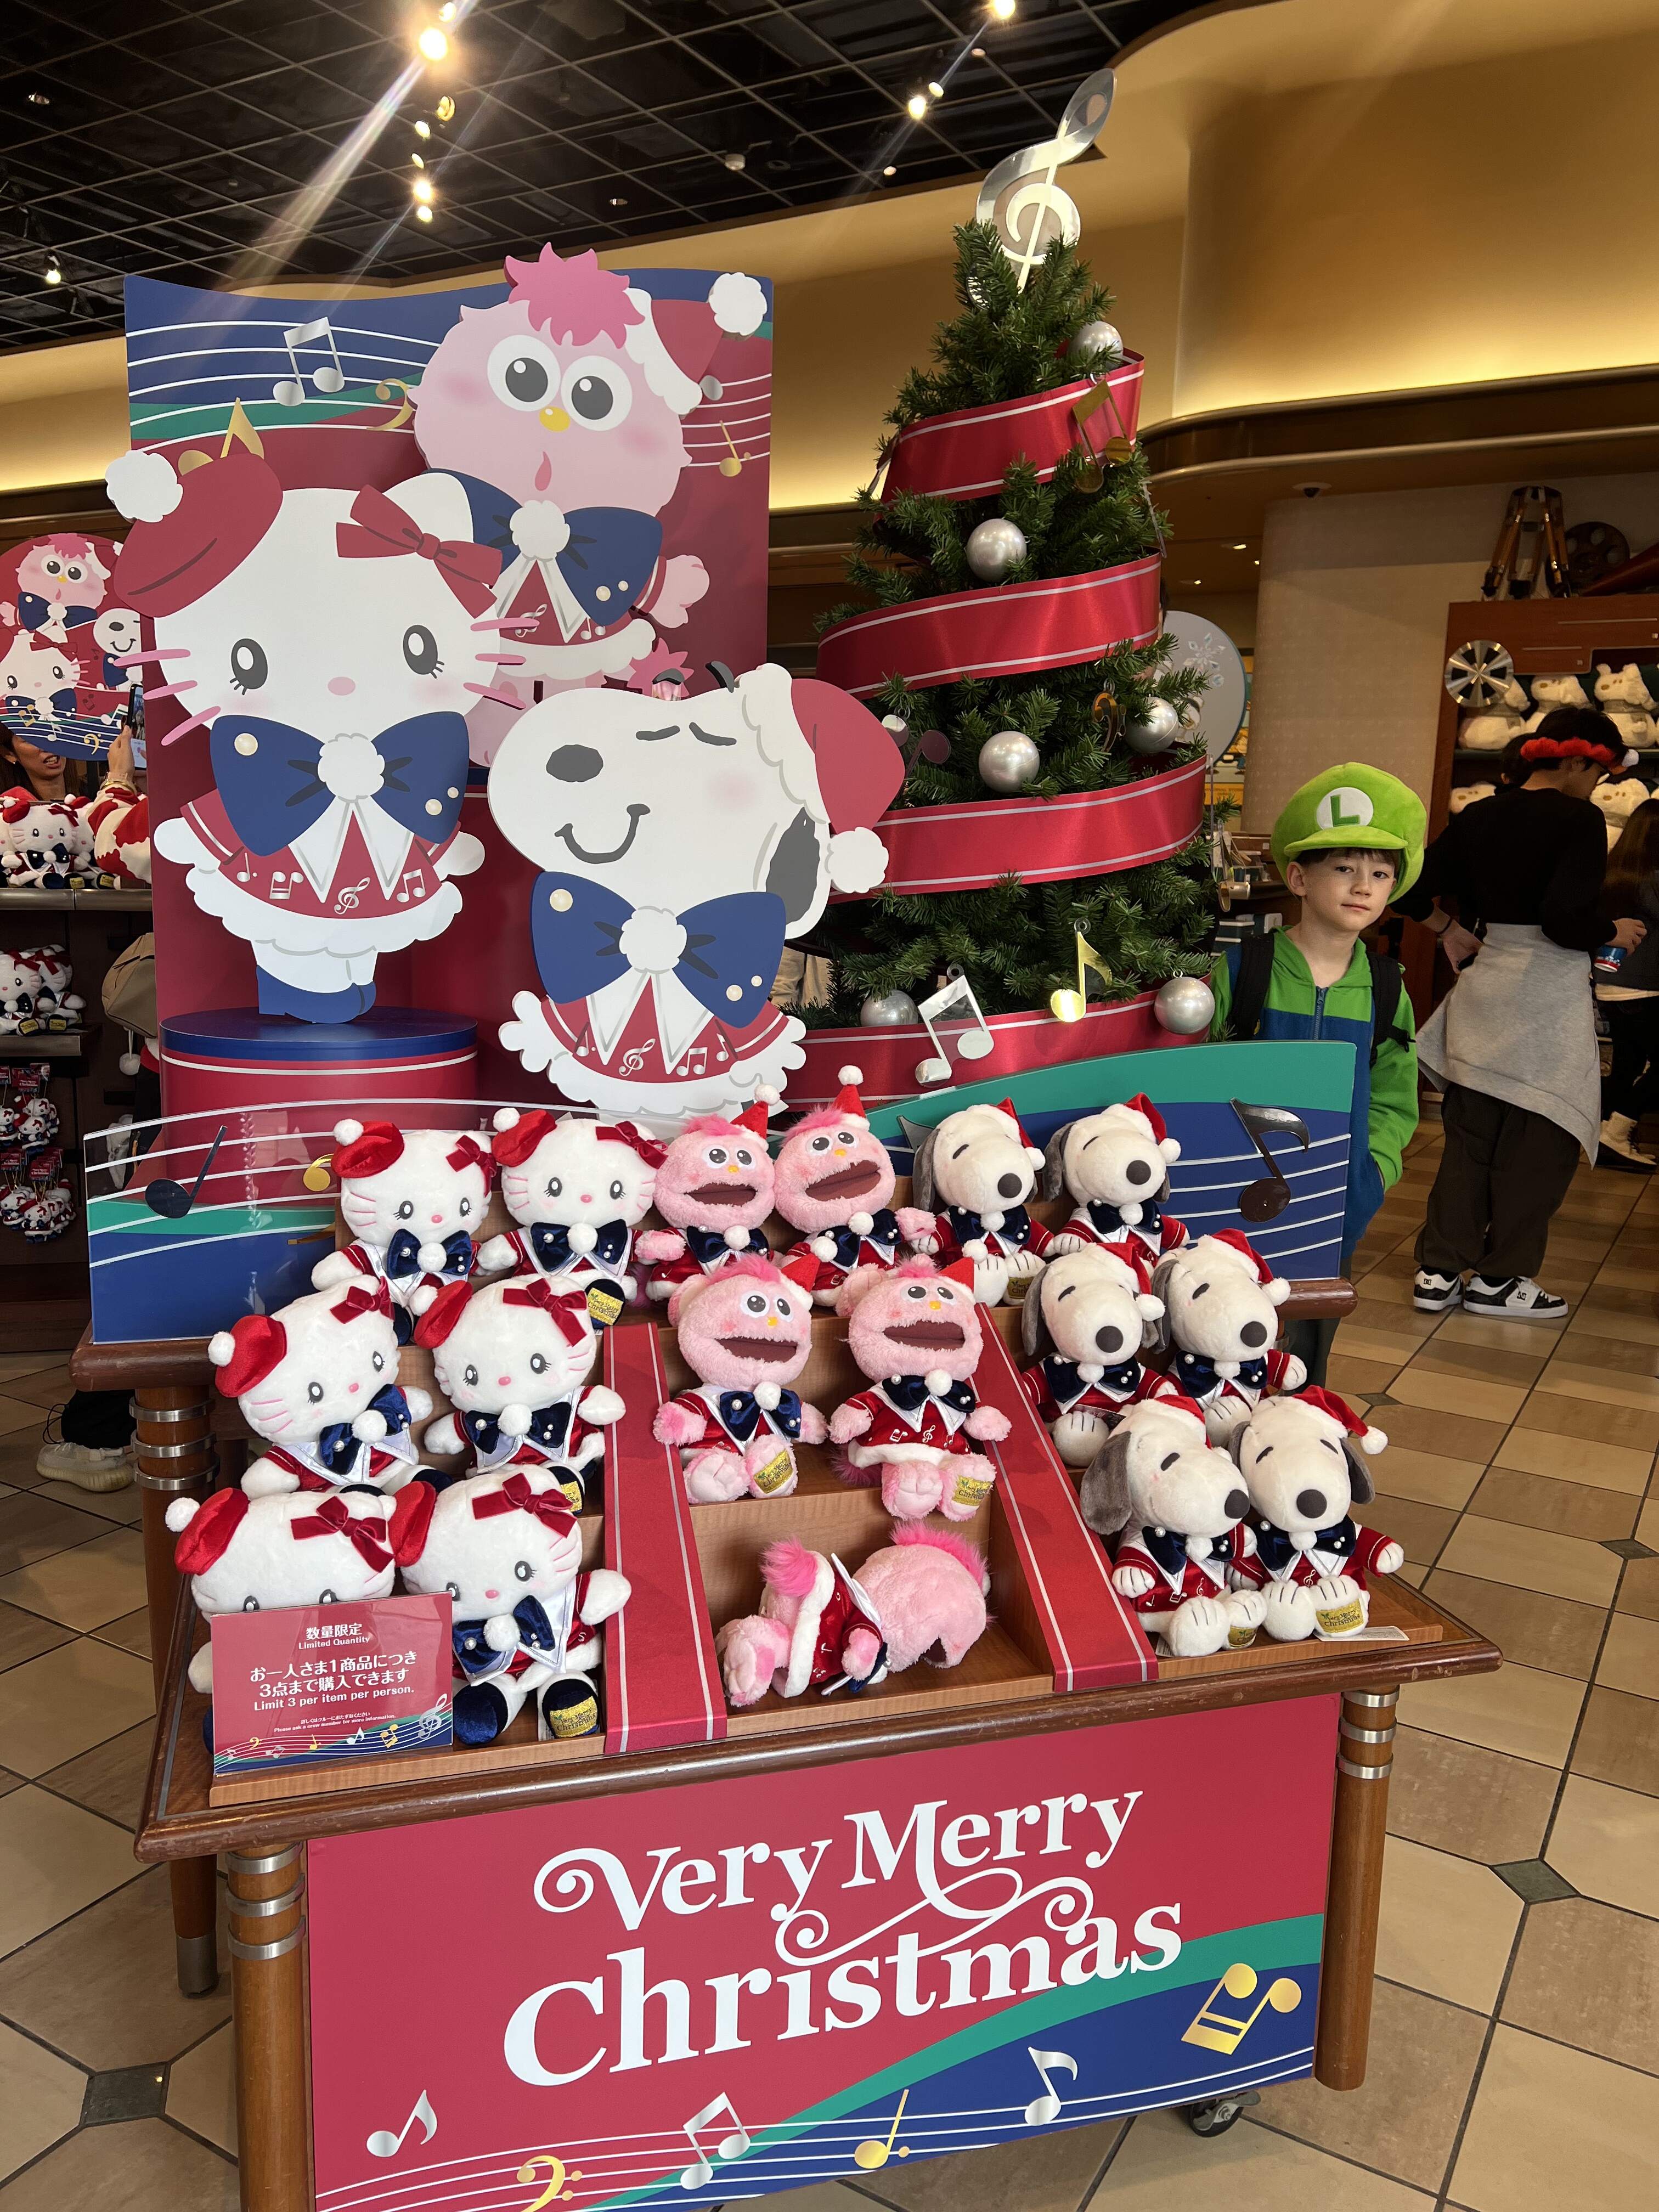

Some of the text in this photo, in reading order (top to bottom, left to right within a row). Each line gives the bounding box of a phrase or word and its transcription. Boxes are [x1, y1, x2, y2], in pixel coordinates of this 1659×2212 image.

[1330, 794, 1359, 827] L
[298, 1636, 370, 1650] Limited Quantity
[306, 1622, 362, 1640] 数量限定
[250, 1650, 417, 1682] お一人さま1商品につき
[259, 1668, 409, 1697] 3点まで購入できます
[254, 1686, 414, 1711] Limit 3 per item per person.
[534, 1791, 1143, 1931] Very Merry
[504, 1903, 1182, 2086] Christmas
